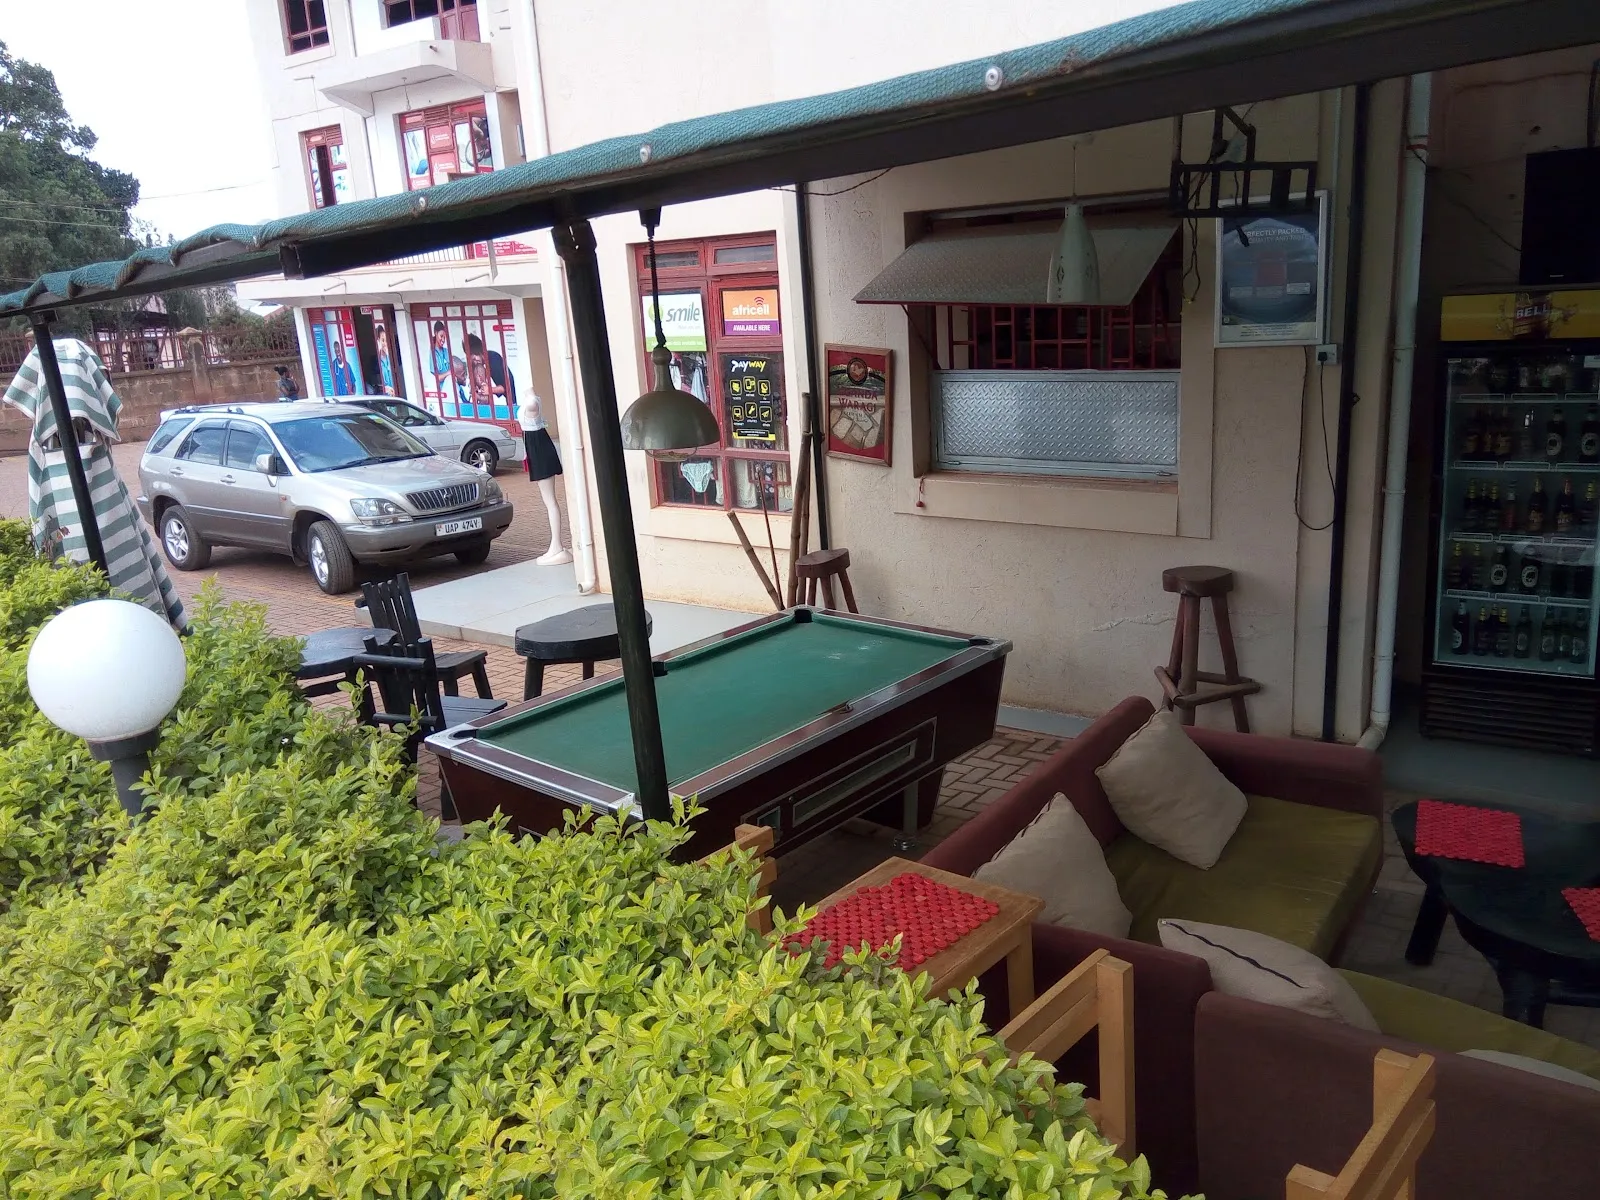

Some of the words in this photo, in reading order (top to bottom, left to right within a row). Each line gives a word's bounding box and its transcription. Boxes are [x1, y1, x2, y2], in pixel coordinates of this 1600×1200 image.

[666, 302, 700, 322] smile
[732, 304, 769, 316] africell
[1516, 303, 1547, 318] BELL
[838, 397, 876, 412] WARAGI
[445, 522, 458, 533] UAP
[462, 519, 478, 530] 474V
